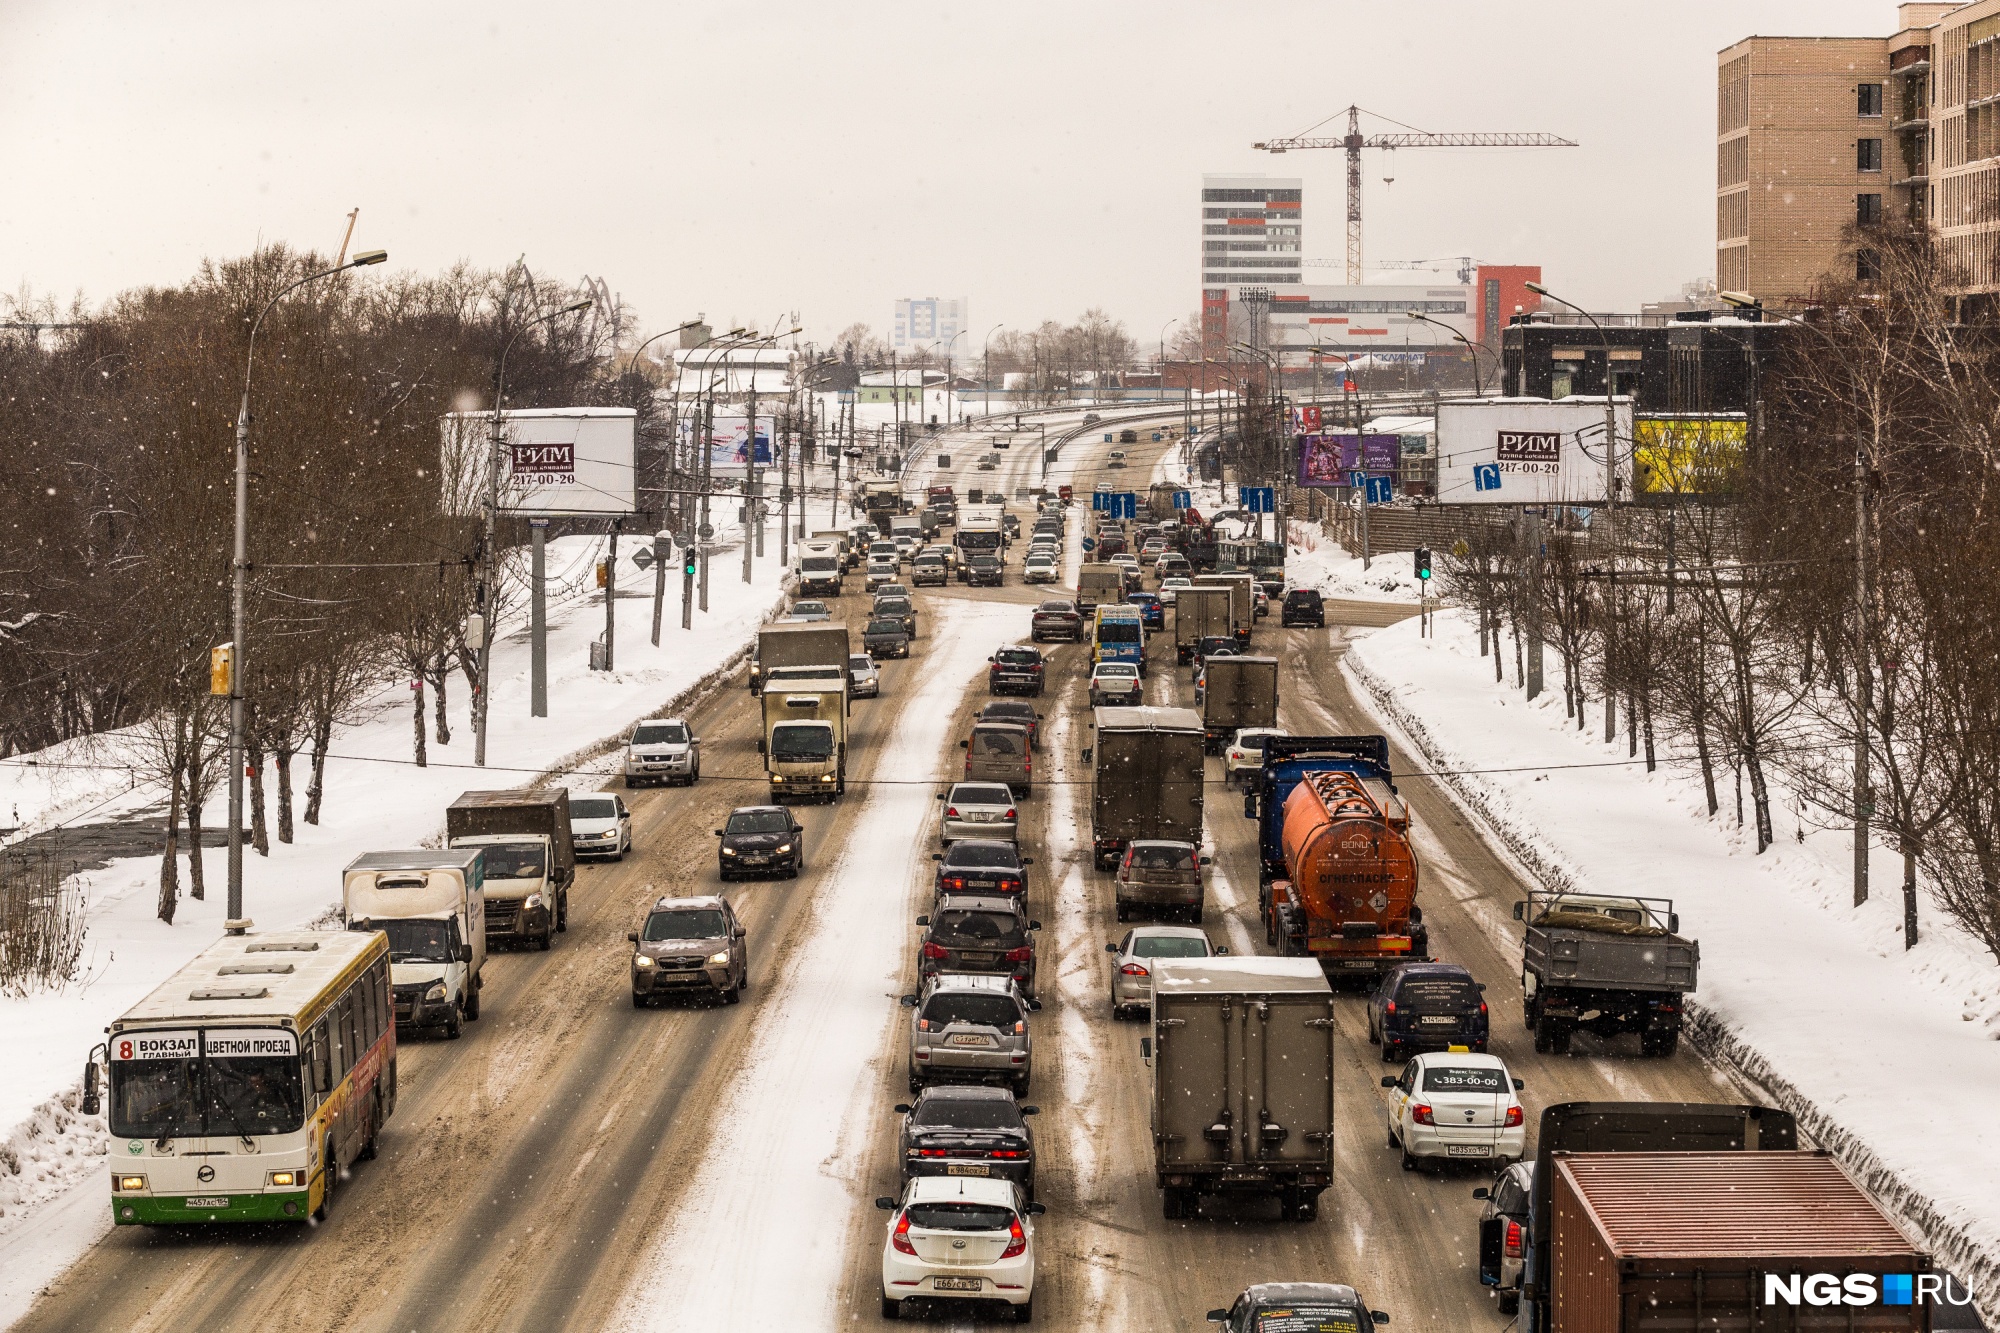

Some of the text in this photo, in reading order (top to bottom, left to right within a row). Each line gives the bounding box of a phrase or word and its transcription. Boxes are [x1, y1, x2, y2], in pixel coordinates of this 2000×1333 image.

[1501, 434, 1557, 453] РИМ
[515, 447, 571, 463] РИМ
[1499, 462, 1560, 474] 217-00-20
[514, 475, 574, 484] 217-00-20
[1319, 873, 1396, 884] ОГНЕОПАСНО
[120, 1041, 134, 1060] 8
[139, 1039, 196, 1051] ВОКЗАЛ
[206, 1038, 291, 1055] ЦВЕТНОЙ ПРОЕЗД
[1443, 1076, 1498, 1086] 383-00-00
